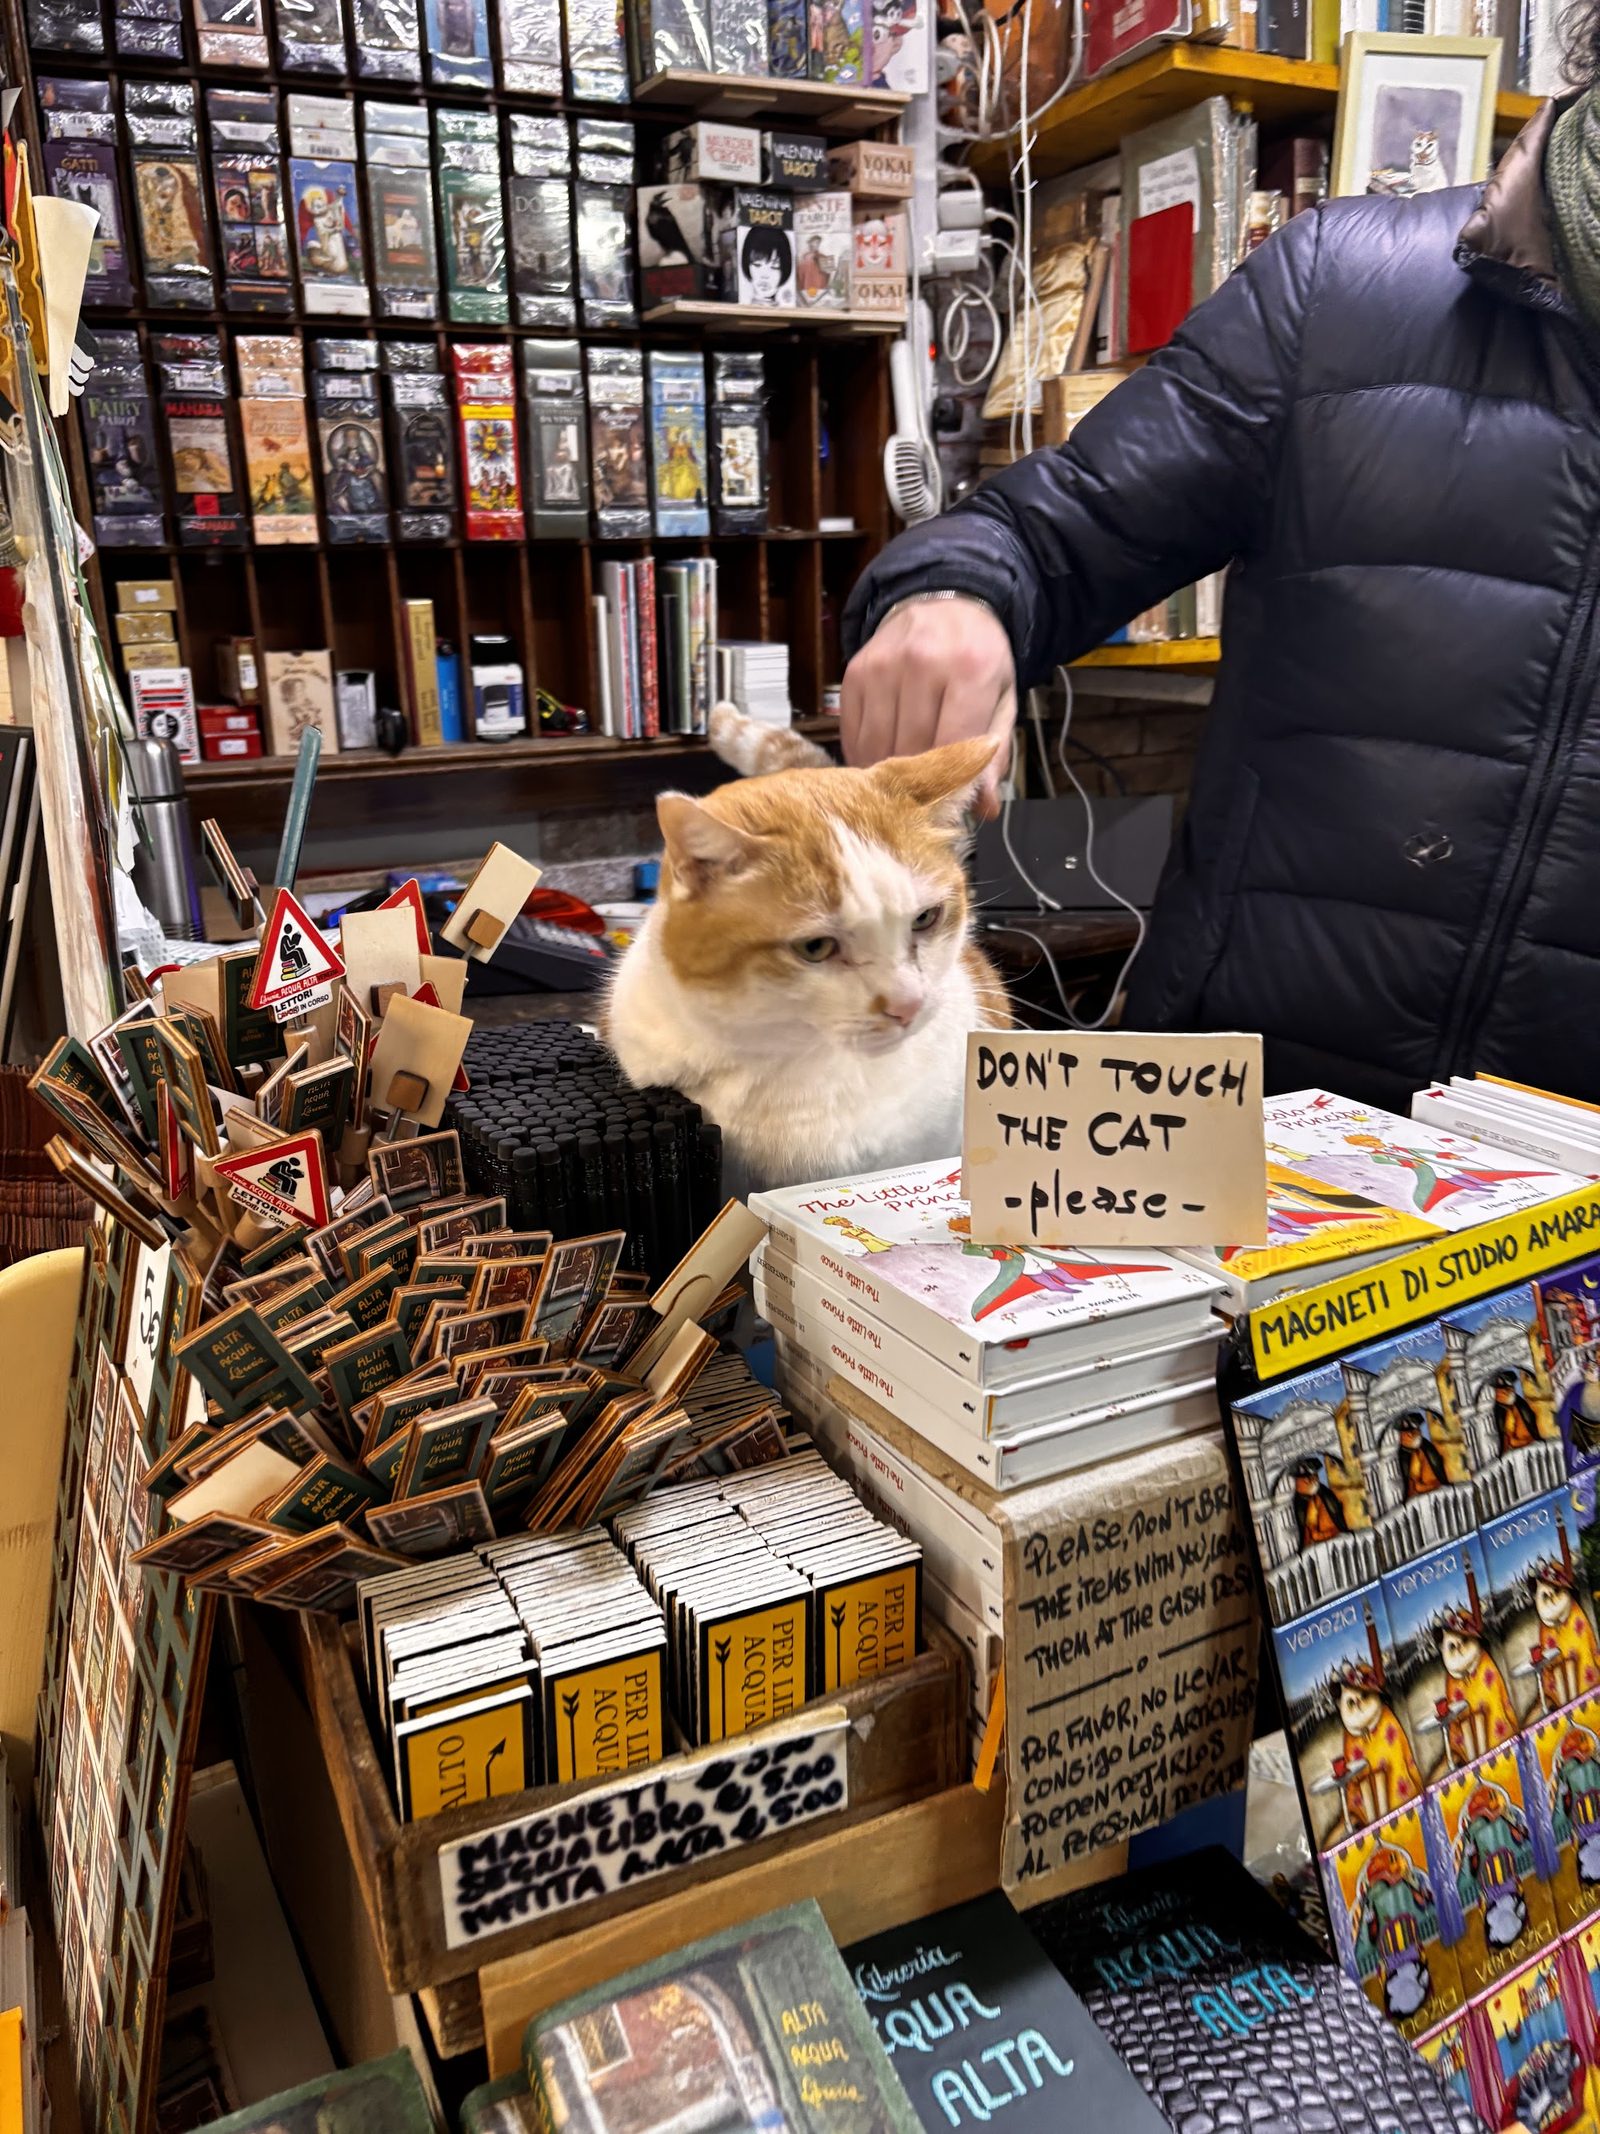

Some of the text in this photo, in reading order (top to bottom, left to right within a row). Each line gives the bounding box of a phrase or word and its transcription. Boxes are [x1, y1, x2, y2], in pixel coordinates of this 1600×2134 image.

[774, 143, 824, 160] VALENTINA
[863, 154, 913, 174] YOKAI
[782, 159, 817, 178] TAROT
[739, 192, 793, 211] VALENTINA
[749, 209, 784, 226] TAROT
[89, 398, 141, 419] FAIRY
[98, 415, 137, 427] TAROT
[281, 981, 303, 996] ACQUA
[303, 975, 319, 988] ALTA
[275, 989, 313, 1012] LETTORI
[308, 994, 330, 1009] CORSO
[977, 1046, 1248, 1107] DON'T TOUCH
[303, 1089, 331, 1105] ACQUA
[997, 1111, 1187, 1157] THE CAT
[233, 1187, 283, 1216] LETTORI
[249, 1183, 275, 1204] ACQUA
[275, 1199, 295, 1215] ALTA
[798, 1185, 930, 1214] The Little
[884, 1191, 962, 1213] Princ
[259, 1208, 268, 1217] IN
[268, 1213, 291, 1229] CORS
[386, 1248, 409, 1266] ALTA
[820, 1254, 880, 1304] The Little Prince
[1259, 1279, 1390, 1354] MAGNETI
[1402, 1266, 1429, 1302] DI
[1436, 1233, 1519, 1289] STUDIO
[357, 1288, 385, 1312] ALTA
[278, 1306, 306, 1329] ALTA
[820, 1298, 882, 1350] The Little Prince
[211, 1330, 245, 1356] ALTA
[219, 1344, 256, 1368] ACQUA
[358, 1359, 392, 1380] ACQUA
[360, 1374, 398, 1394] Libreria
[831, 1344, 895, 1399] The Little Prince
[430, 1436, 464, 1454] ACQUA
[505, 1447, 536, 1467] ACQUA
[845, 1430, 869, 1460] Prince
[869, 1452, 891, 1480] Little
[300, 1478, 331, 1507] ALTA
[889, 1469, 906, 1493] The
[311, 1485, 344, 1515] ACQUA
[1135, 1550, 1175, 1588] WITH
[884, 1584, 905, 1637] PER
[771, 1618, 795, 1675] PER
[855, 1601, 879, 1680] ACQU
[1095, 1615, 1118, 1650] AT
[624, 1669, 649, 1725] PER
[741, 1635, 767, 1730] ACQUA
[1020, 1729, 1064, 1776] POR
[1141, 1686, 1168, 1717] NO
[767, 1779, 844, 1826] 5.00
[455, 1800, 706, 1907] SEGNALIBRO
[760, 1754, 836, 1798] 5.00
[456, 1779, 670, 1876] MAGNETI
[1016, 1848, 1052, 1882] AL
[1093, 1922, 1242, 1993] ACQUA
[854, 1945, 963, 2002] Libreria
[1191, 1962, 1316, 2039] ALTA
[781, 2000, 829, 2036] ALTA
[789, 2036, 850, 2070] ACQUA
[931, 2028, 1075, 2128] ALTA
